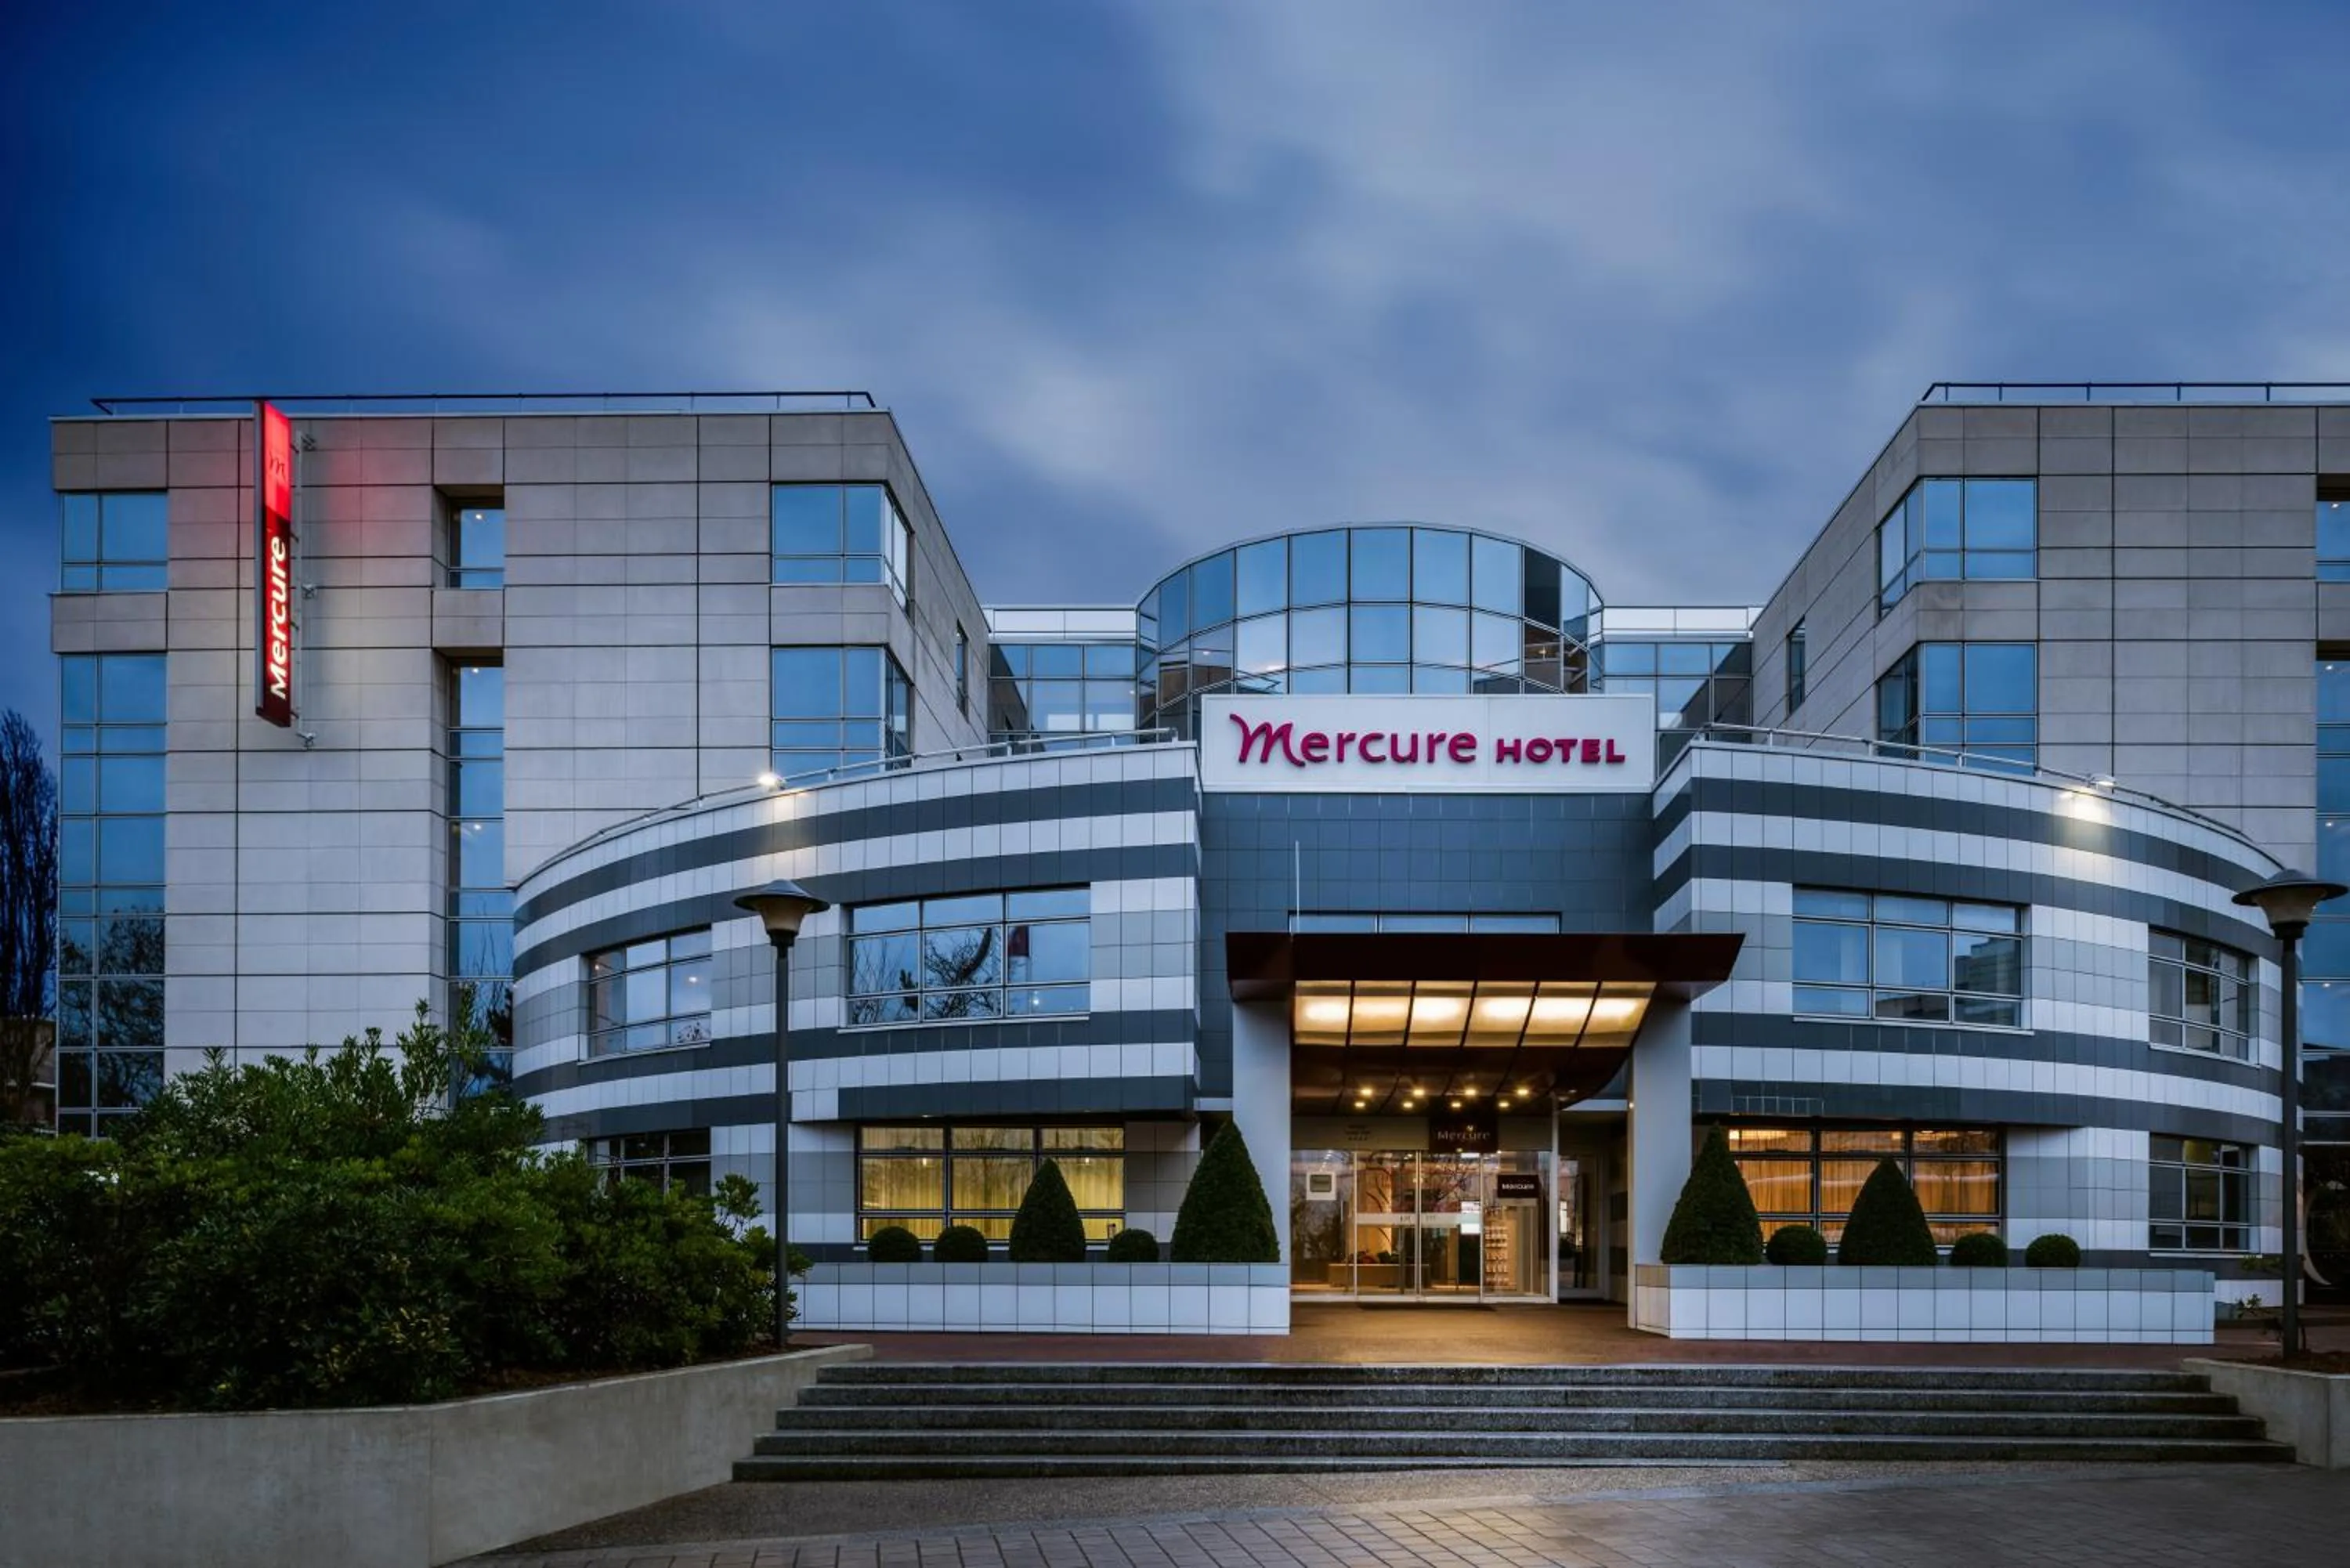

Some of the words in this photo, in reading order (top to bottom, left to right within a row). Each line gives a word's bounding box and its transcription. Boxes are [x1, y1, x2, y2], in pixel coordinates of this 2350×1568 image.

[269, 535, 287, 699] Mercure
[1230, 714, 1477, 767] Mercure
[1496, 737, 1626, 764] HOTEL
